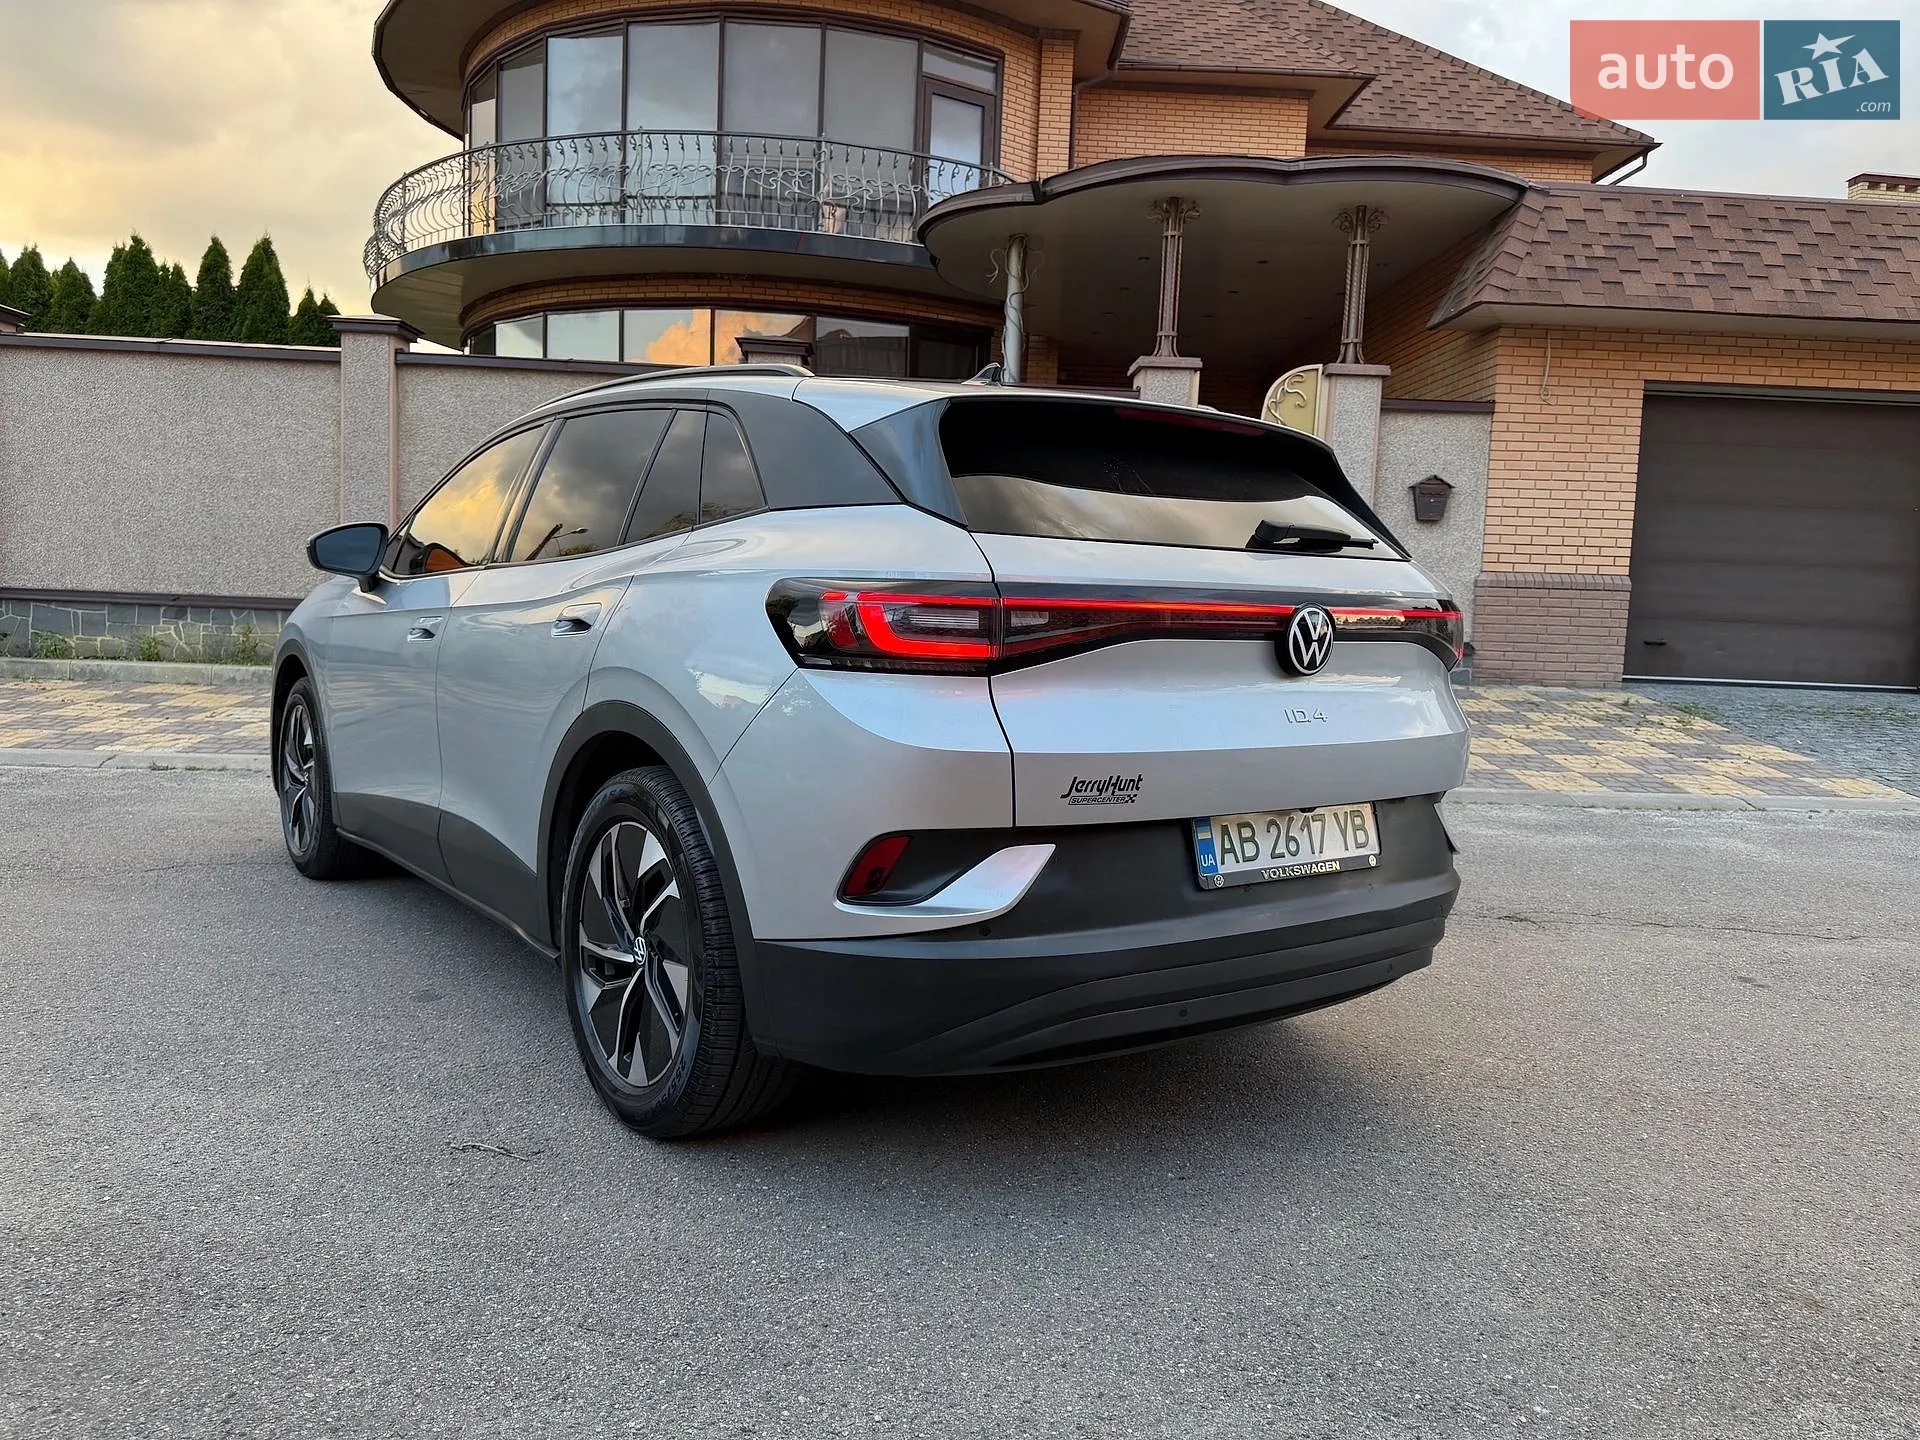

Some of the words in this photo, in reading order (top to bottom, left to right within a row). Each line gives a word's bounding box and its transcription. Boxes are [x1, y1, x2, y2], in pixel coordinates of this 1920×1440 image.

[1071, 796, 1126, 804] SUPERCENTER
[1220, 820, 1260, 866] AB
[1266, 813, 1327, 860] 2617
[1333, 809, 1370, 851] YB
[1201, 854, 1216, 868] UA
[1261, 860, 1341, 880] VOLKSWAGEN
